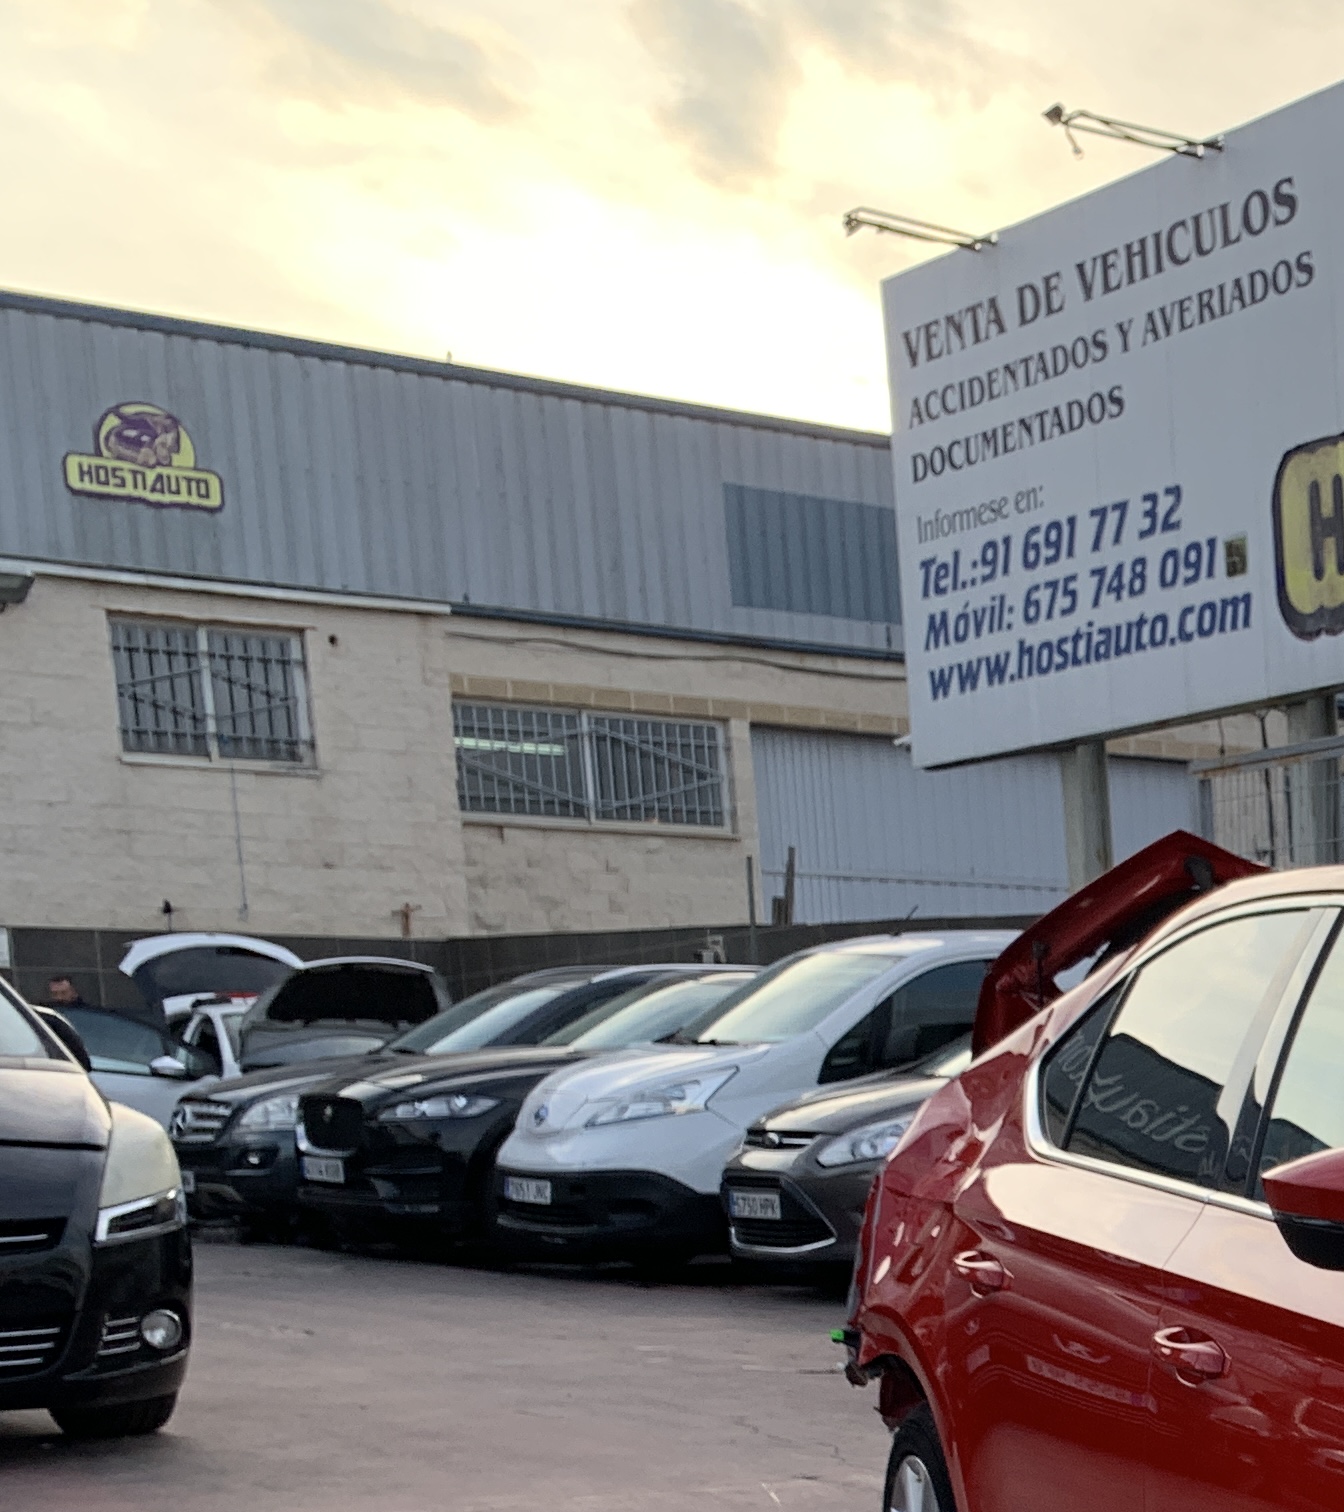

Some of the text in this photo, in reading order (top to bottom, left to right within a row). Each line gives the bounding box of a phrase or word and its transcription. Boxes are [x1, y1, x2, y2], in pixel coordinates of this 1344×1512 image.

[902, 176, 1298, 368] VENTA DE VEHICULOS
[909, 250, 1315, 430] ACCIDENTADOS Y AVERIADOS
[78, 461, 211, 500] HOSTIAUTO
[911, 384, 1125, 484] DOCUMENTADOS
[916, 484, 1045, 545] Informese en:
[1022, 514, 1078, 572] 691
[1089, 499, 1130, 553] 77
[1138, 484, 1182, 541] 32
[924, 536, 1217, 652] Móvil: 675 748 091
[929, 592, 1253, 701] www.hostiauto.com
